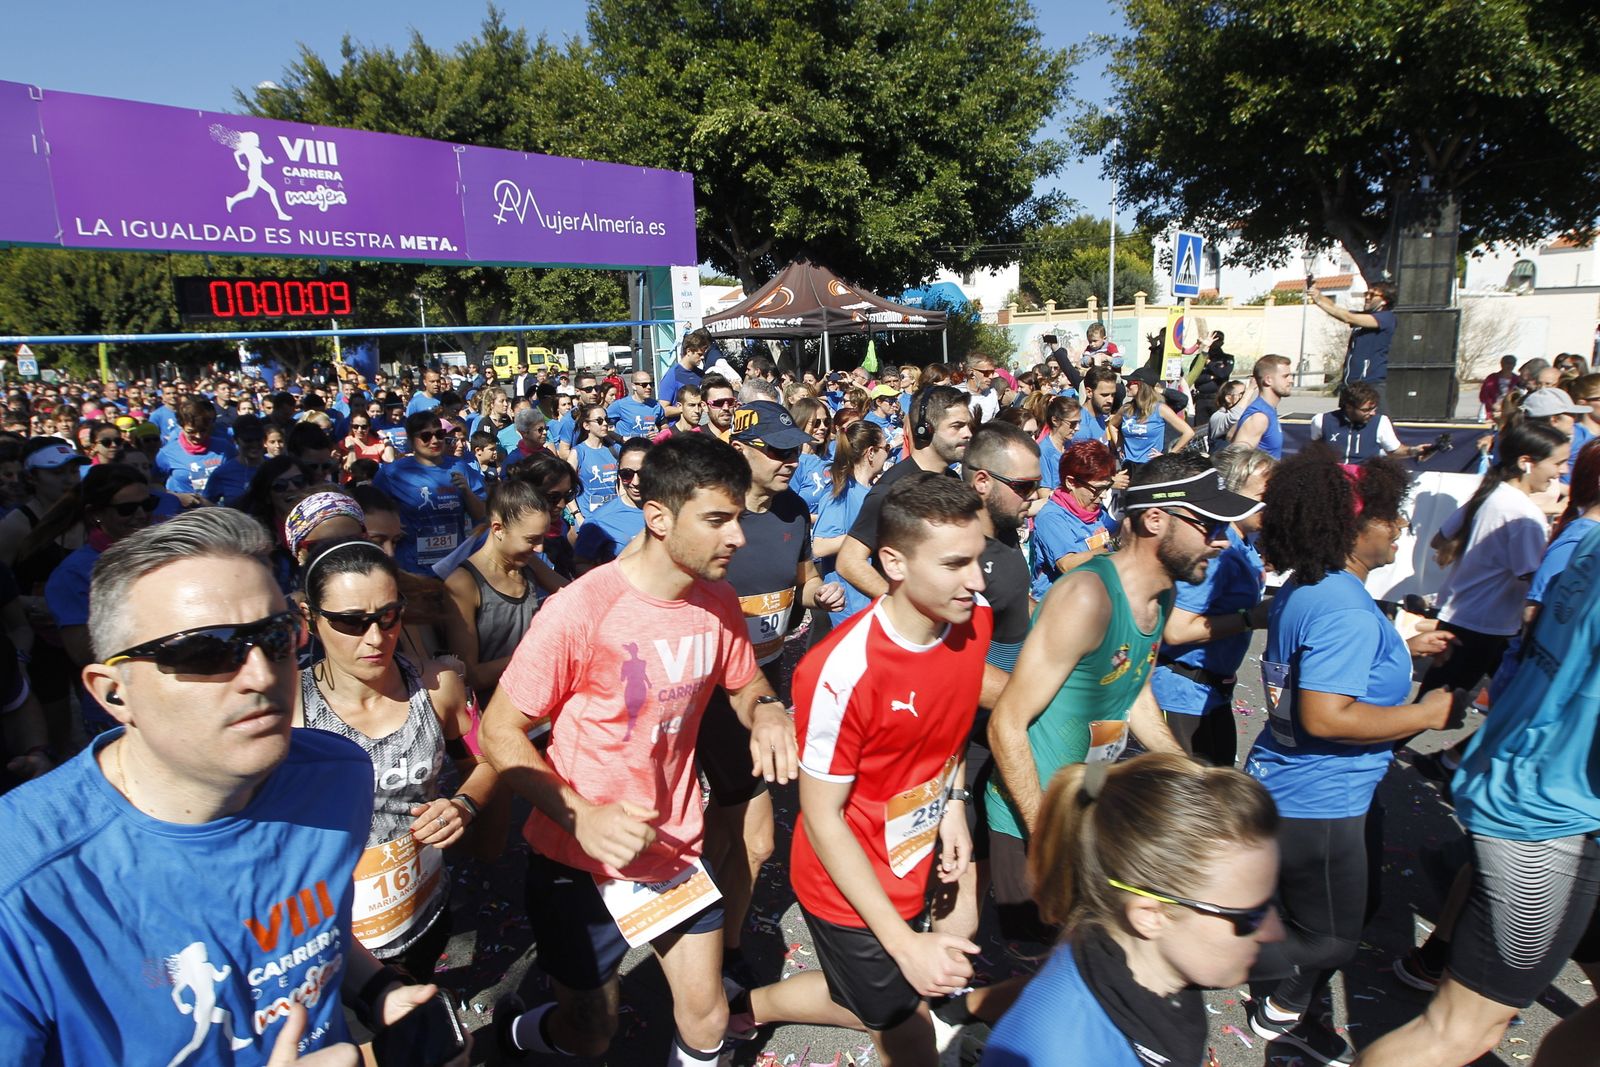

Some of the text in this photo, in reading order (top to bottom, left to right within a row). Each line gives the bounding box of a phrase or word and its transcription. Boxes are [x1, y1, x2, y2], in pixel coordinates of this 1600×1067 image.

[278, 135, 338, 166] VIII
[282, 166, 343, 181] CARRERA
[284, 177, 344, 189] DE LA
[285, 185, 347, 212] mujer
[75, 217, 458, 252] LA IGUALDAD ES NUESTRA META.
[209, 281, 352, 317] 00:00:09
[425, 535, 452, 548] 1281
[760, 613, 779, 633] 50
[372, 855, 422, 899] 161
[243, 879, 337, 953] VIII
[367, 895, 398, 913] MARIA
[247, 924, 341, 987] CARRERA
